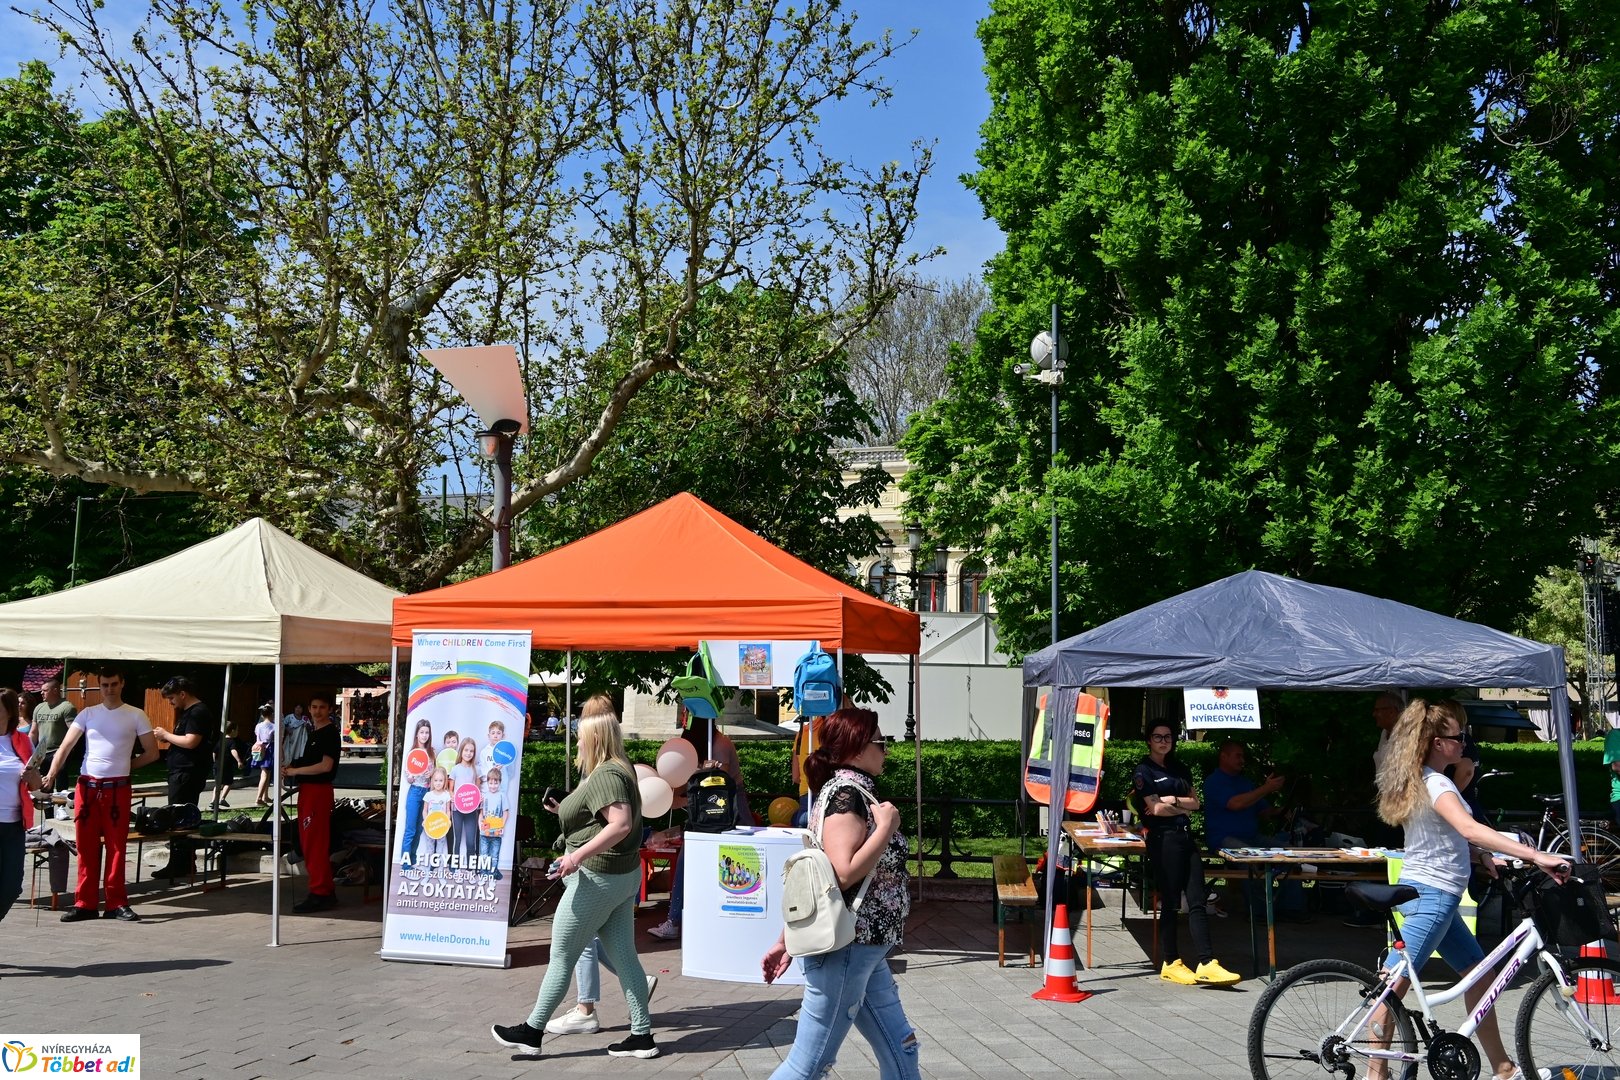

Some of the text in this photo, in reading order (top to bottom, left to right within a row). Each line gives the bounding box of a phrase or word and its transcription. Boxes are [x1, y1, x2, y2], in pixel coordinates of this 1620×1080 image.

[417, 638, 526, 648] Where CHILDREN Come First
[1189, 702, 1254, 711] POLGÁRŐRSÉG
[1192, 713, 1254, 723] NYÍREGYHÁZA
[1074, 730, 1091, 738] RSÉG
[411, 757, 425, 768] Fun!
[400, 852, 496, 873] A FIGYELEM,
[399, 869, 426, 878] amire
[397, 881, 499, 904] AZ OKTATÁS,
[396, 899, 497, 914] amit megérdemelnek.
[400, 931, 490, 946] www.HelenDoron.hu
